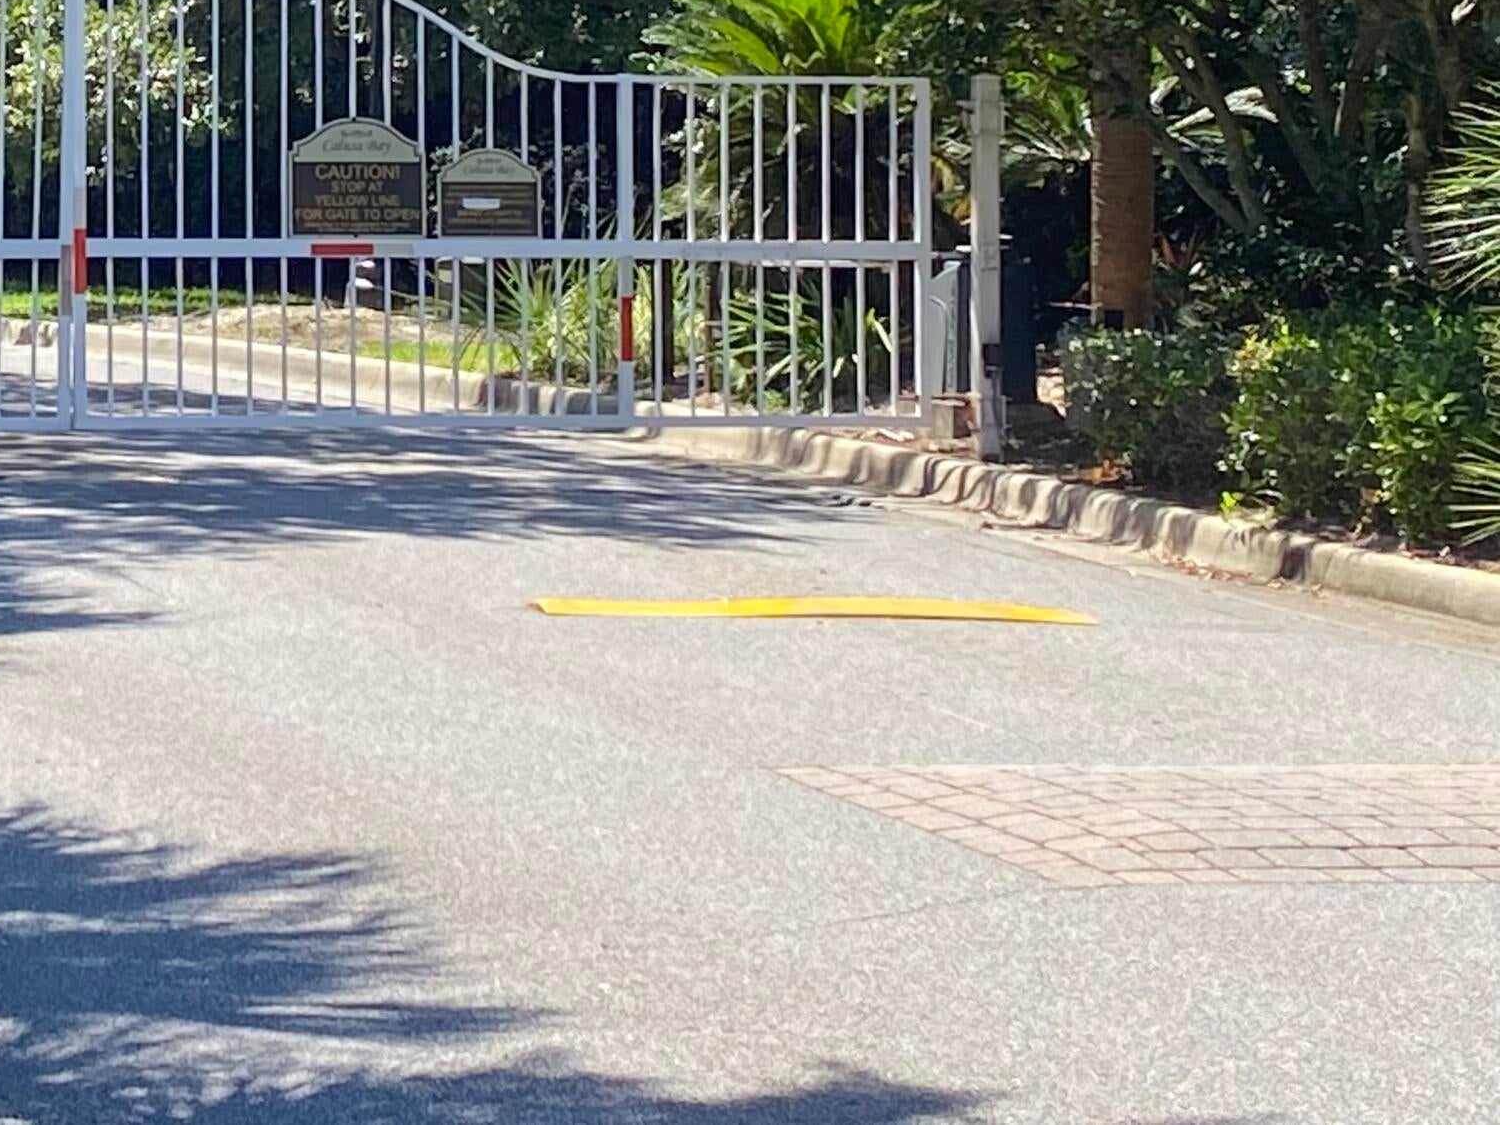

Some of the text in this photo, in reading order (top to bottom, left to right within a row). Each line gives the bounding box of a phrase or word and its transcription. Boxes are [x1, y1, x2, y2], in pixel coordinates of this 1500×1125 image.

[315, 163, 400, 180] CAUTION!
[331, 181, 384, 193] STOP AT
[315, 195, 369, 207] YELLOW
[324, 208, 360, 221] GATE
[363, 208, 380, 221] TO
[383, 208, 421, 221] OPEN
